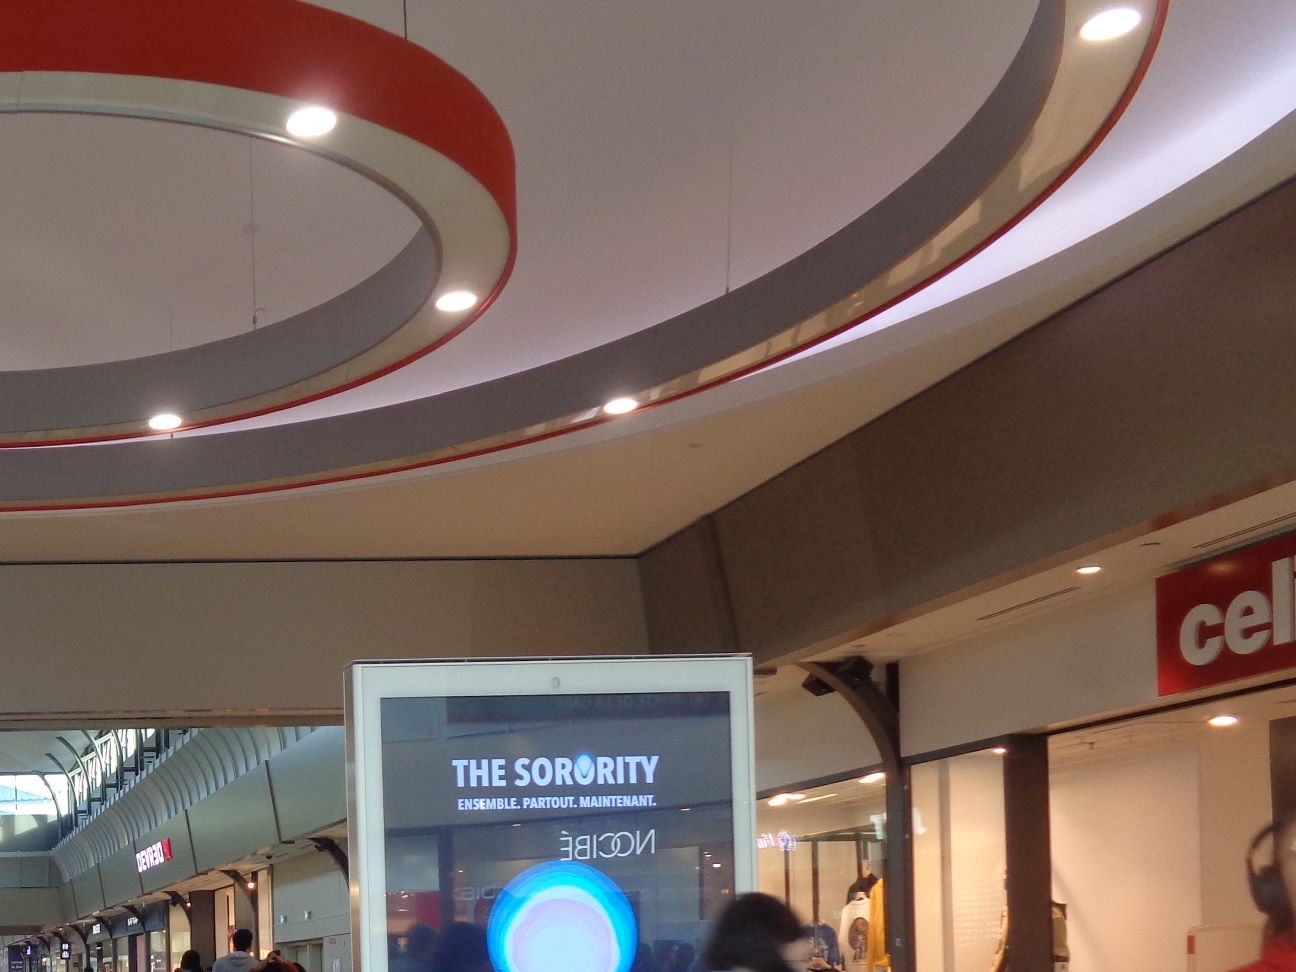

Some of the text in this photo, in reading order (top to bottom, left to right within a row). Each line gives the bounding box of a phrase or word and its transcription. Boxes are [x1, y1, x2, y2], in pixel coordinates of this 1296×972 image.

[1179, 555, 1296, 666] cel
[452, 754, 660, 787] THE SORORITY
[457, 795, 657, 811] ENSEMBLE. PARTOUT. MAINTENANT.
